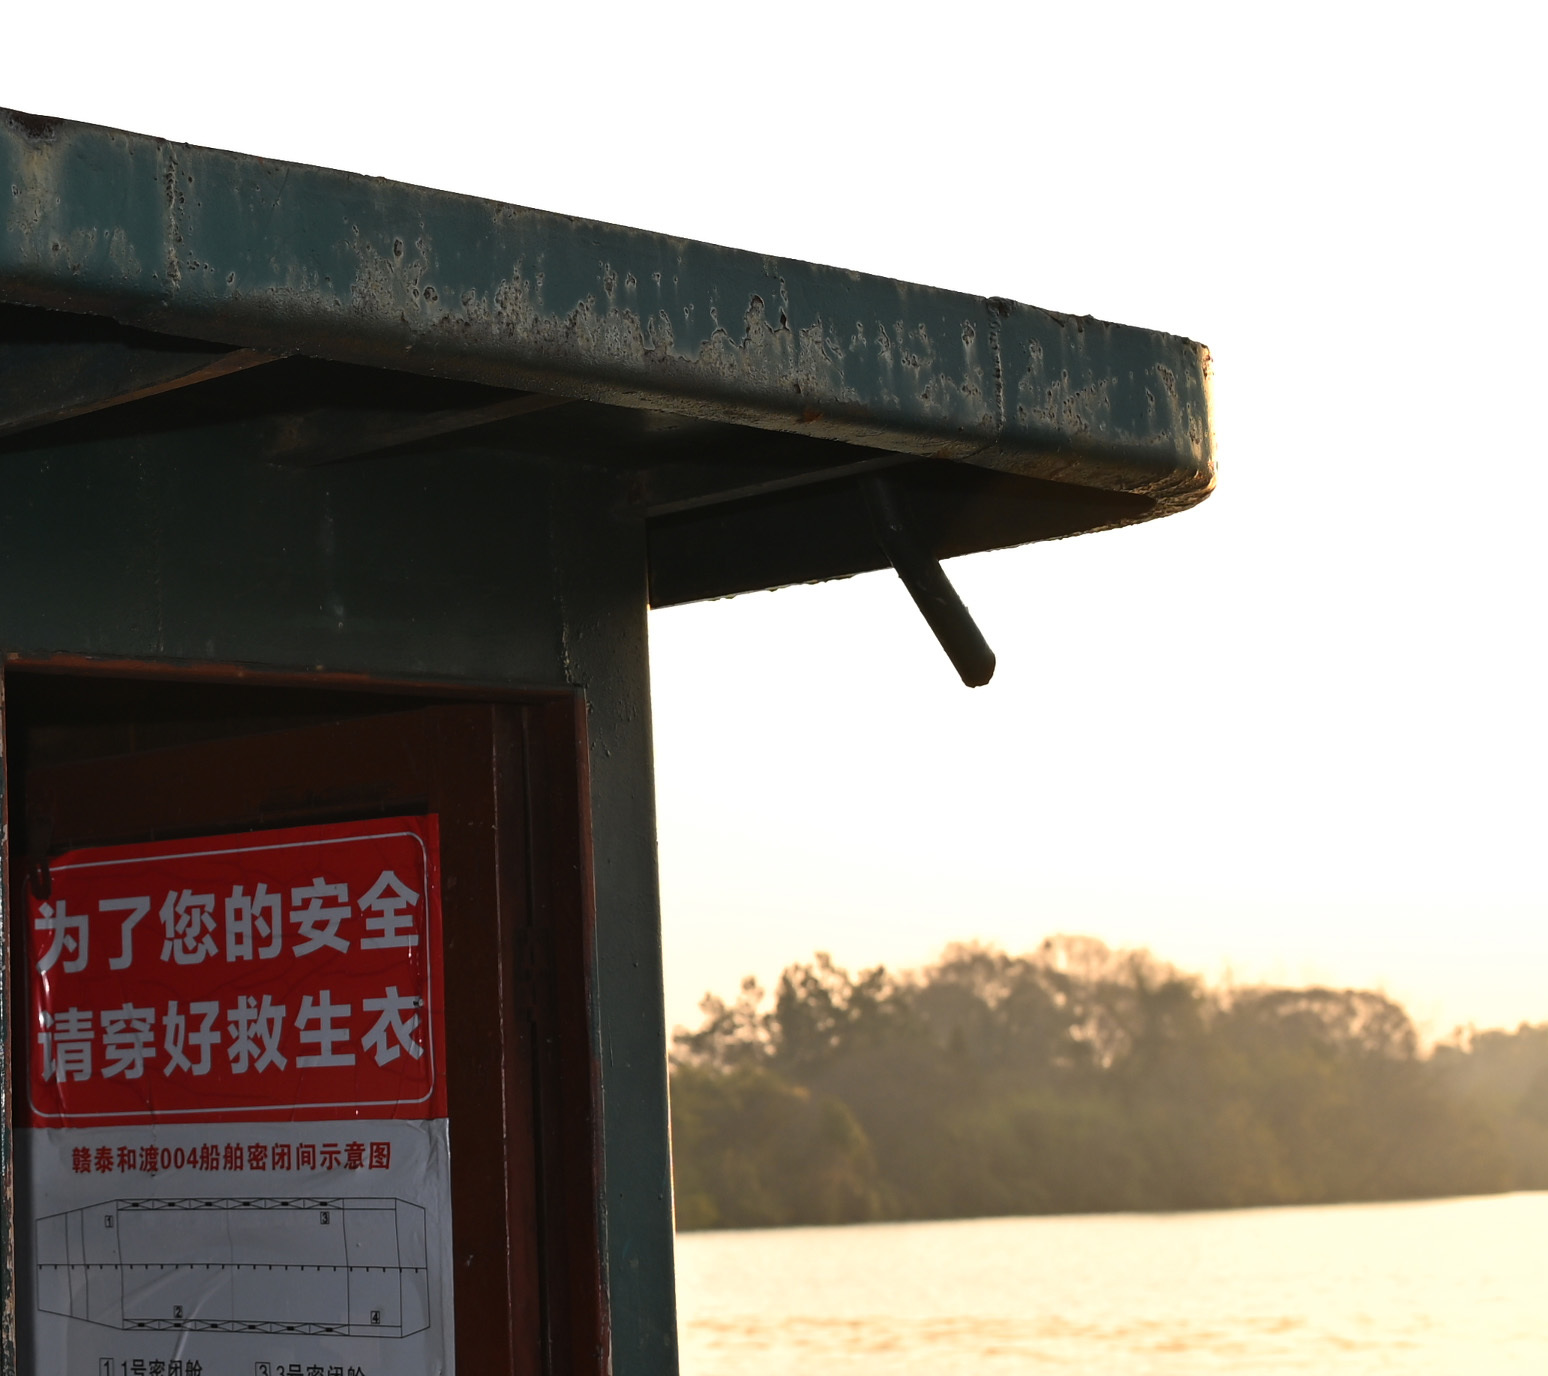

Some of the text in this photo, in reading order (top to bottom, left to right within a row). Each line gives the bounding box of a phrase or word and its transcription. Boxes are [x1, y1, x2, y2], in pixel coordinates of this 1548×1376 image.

[34, 870, 420, 974] 为了您的安全
[37, 986, 425, 1083] 请穿好救生衣
[71, 1141, 392, 1174] 赣泰和渡004船舶密闭间示意图
